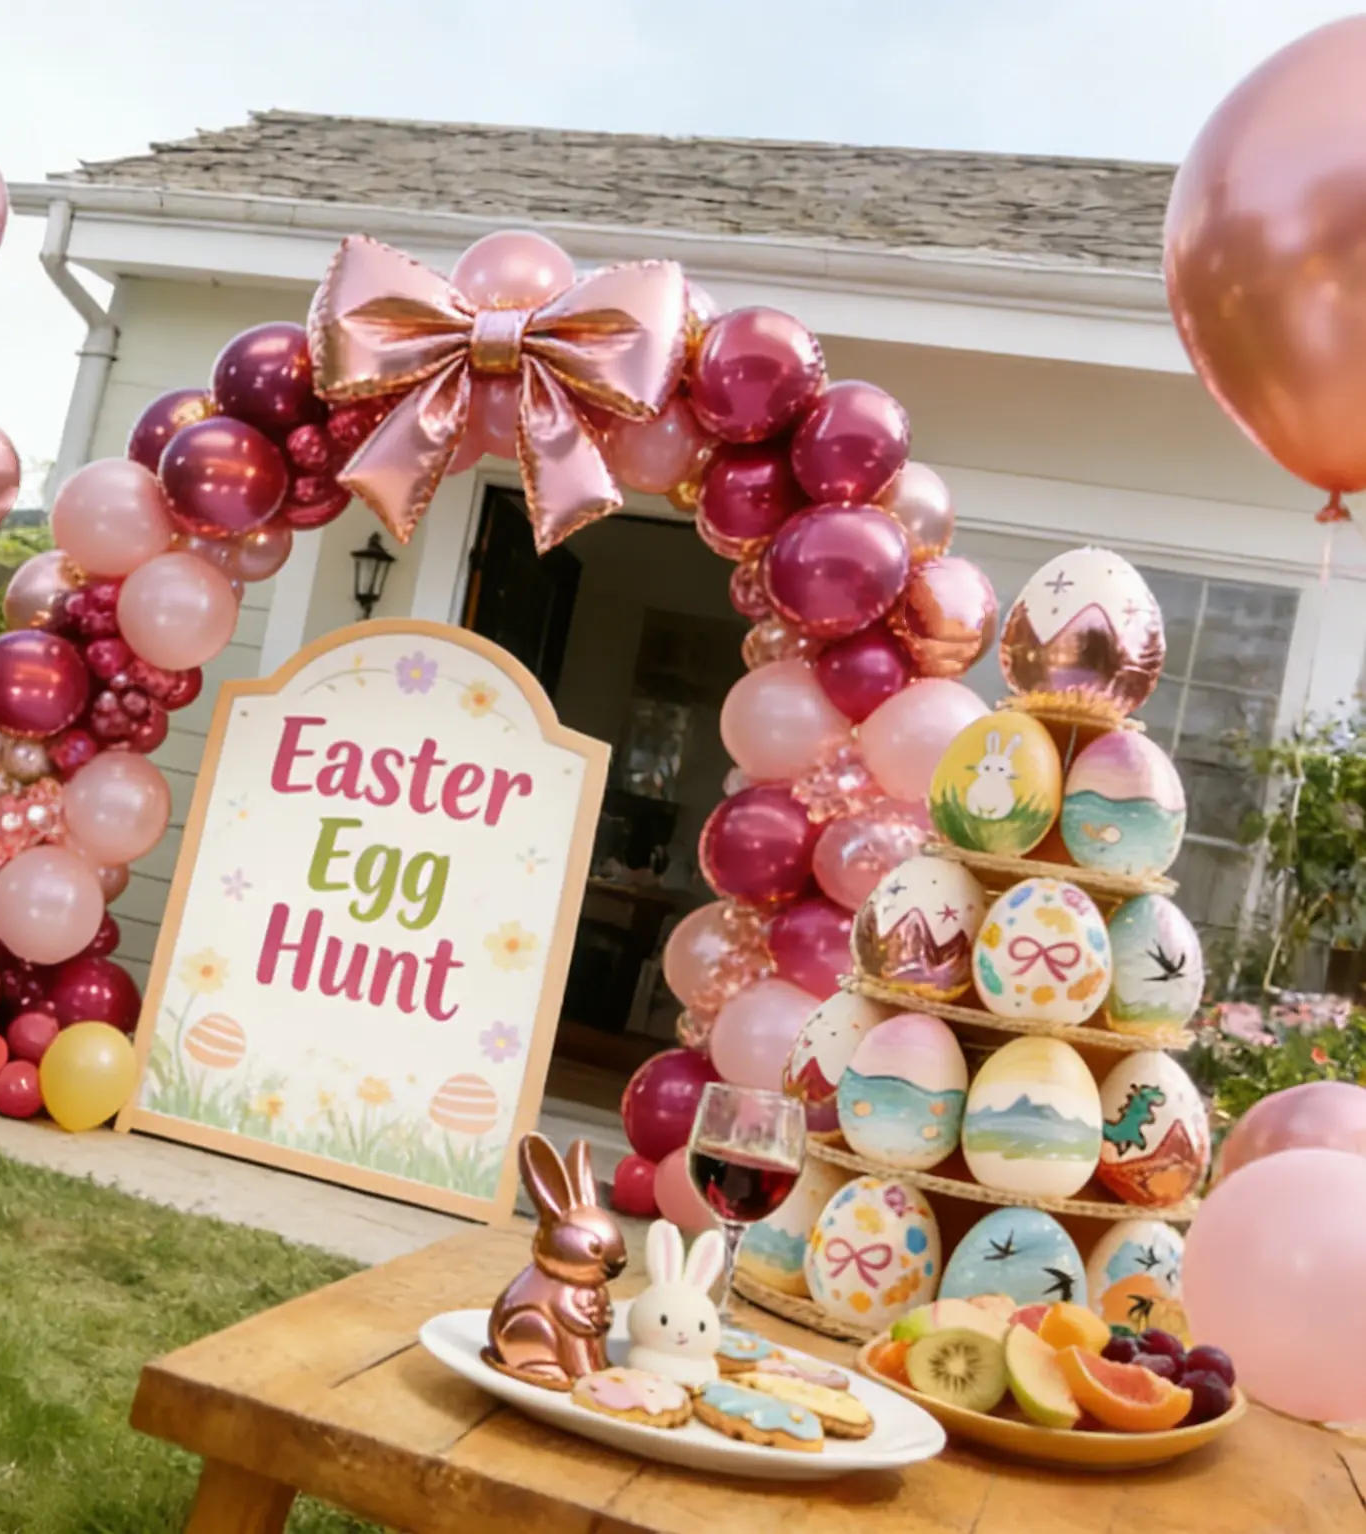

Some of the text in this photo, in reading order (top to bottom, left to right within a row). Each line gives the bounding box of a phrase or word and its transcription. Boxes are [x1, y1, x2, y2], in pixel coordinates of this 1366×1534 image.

[270, 715, 534, 827] Easter
[307, 817, 451, 931] Egg
[256, 902, 466, 1022] Hunt
